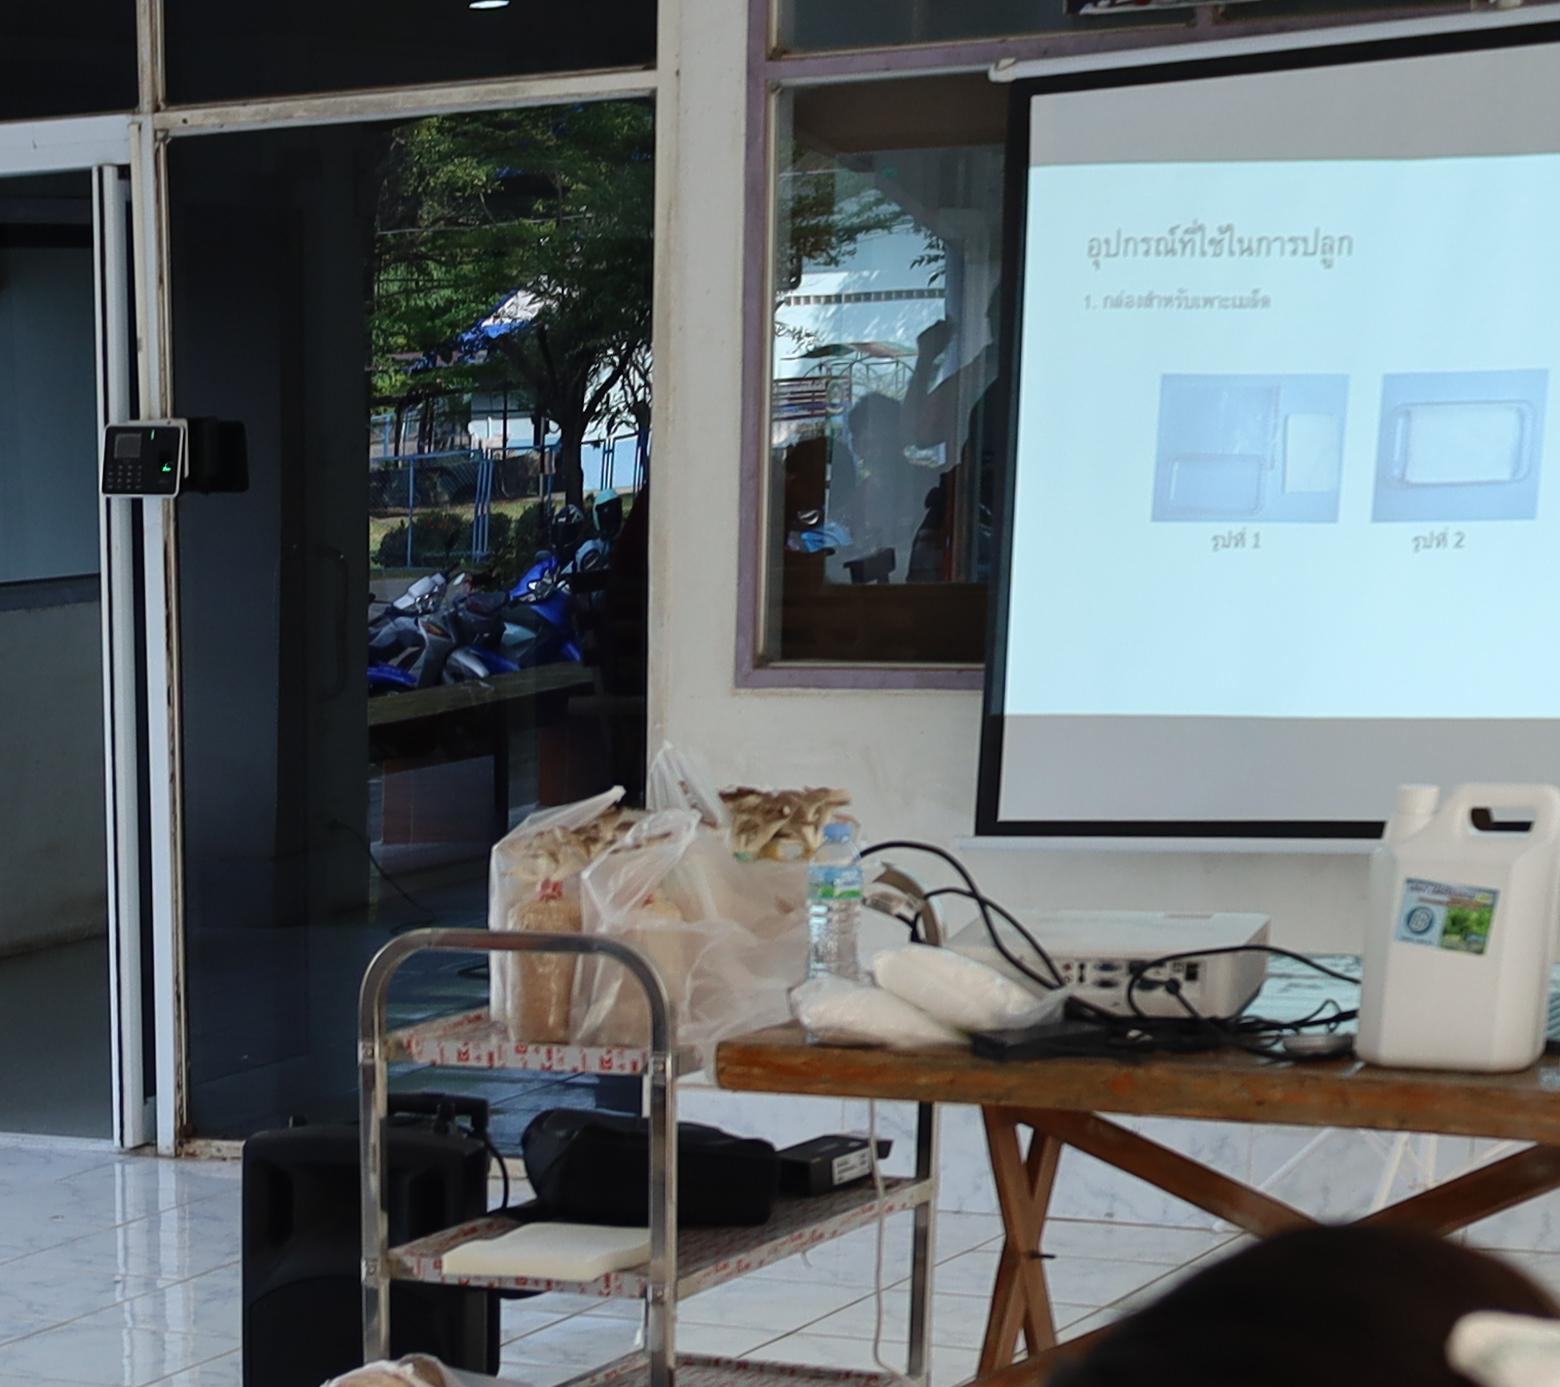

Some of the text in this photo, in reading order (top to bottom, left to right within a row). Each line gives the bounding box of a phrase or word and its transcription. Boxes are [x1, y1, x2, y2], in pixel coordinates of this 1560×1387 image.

[1086, 218, 1354, 270] อุปกรณ์ที่ใช้ในการปลูก
[1453, 531, 1466, 549] 2
